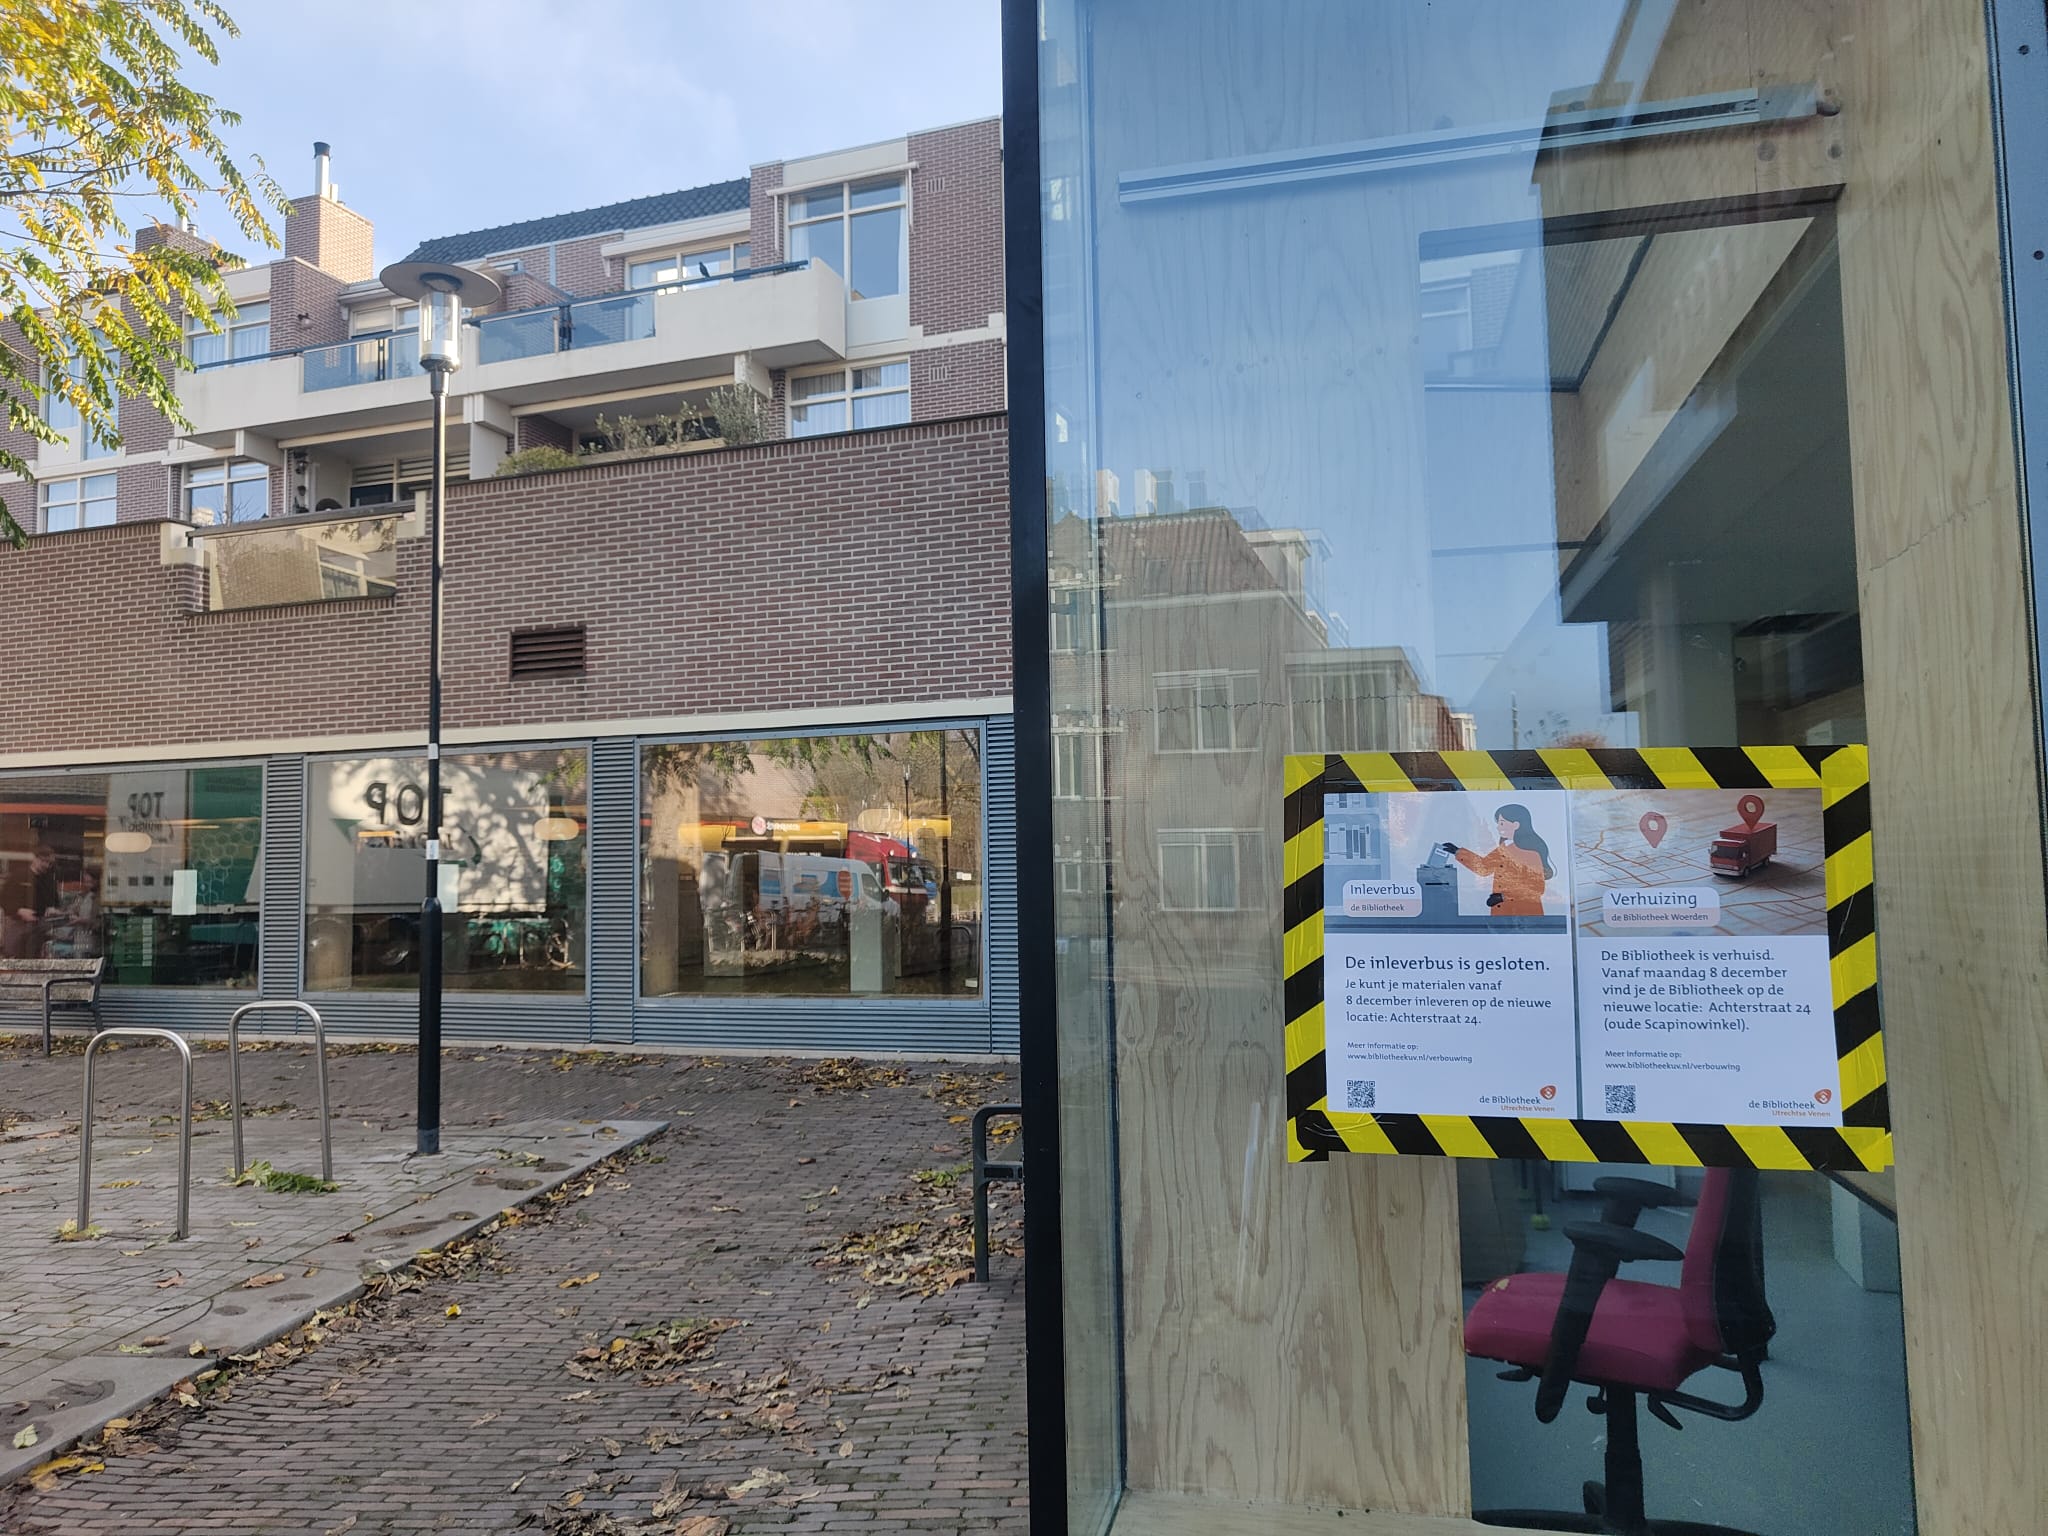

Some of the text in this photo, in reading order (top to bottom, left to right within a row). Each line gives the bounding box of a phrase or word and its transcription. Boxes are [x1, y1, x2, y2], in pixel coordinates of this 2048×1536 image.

[1350, 884, 1416, 896] Inleverbus
[1610, 892, 1697, 908] Verhuizing
[1350, 903, 1405, 912] de Bibliotheek
[1611, 913, 1708, 922] de Bibliotheek Woerden
[1601, 949, 1775, 961] De Bibliotheek is verhuisd.
[1345, 956, 1550, 974] De inleverbus is gesloten.
[1601, 966, 1787, 981] Vanaf maandag 8 december
[1345, 979, 1502, 992] Je kunt je materialen vanaf
[1602, 984, 1784, 998] vind je de Bibliotheek op de
[1346, 995, 1552, 1010] 8 december inleveren op de nieuwe
[1603, 1002, 1811, 1015] nieuwe locatie: Achterstraat 24
[1346, 1012, 1481, 1026] locatie: Achterstraat 24.
[1604, 1018, 1750, 1033] (oude Scapinowinkel).
[1367, 1042, 1406, 1050] informatie
[1406, 1043, 1419, 1051] op:
[1347, 1052, 1473, 1063] www.bibliotheekuv.nl/verbouwing
[1605, 1050, 1625, 1058] Meer
[1626, 1050, 1668, 1058] informatie
[1605, 1061, 1741, 1072] www.bibliotheekuv.nl/verbouwing
[1479, 1096, 1541, 1105] de Bibliotheek
[1748, 1100, 1815, 1109] de Bibliotheek
